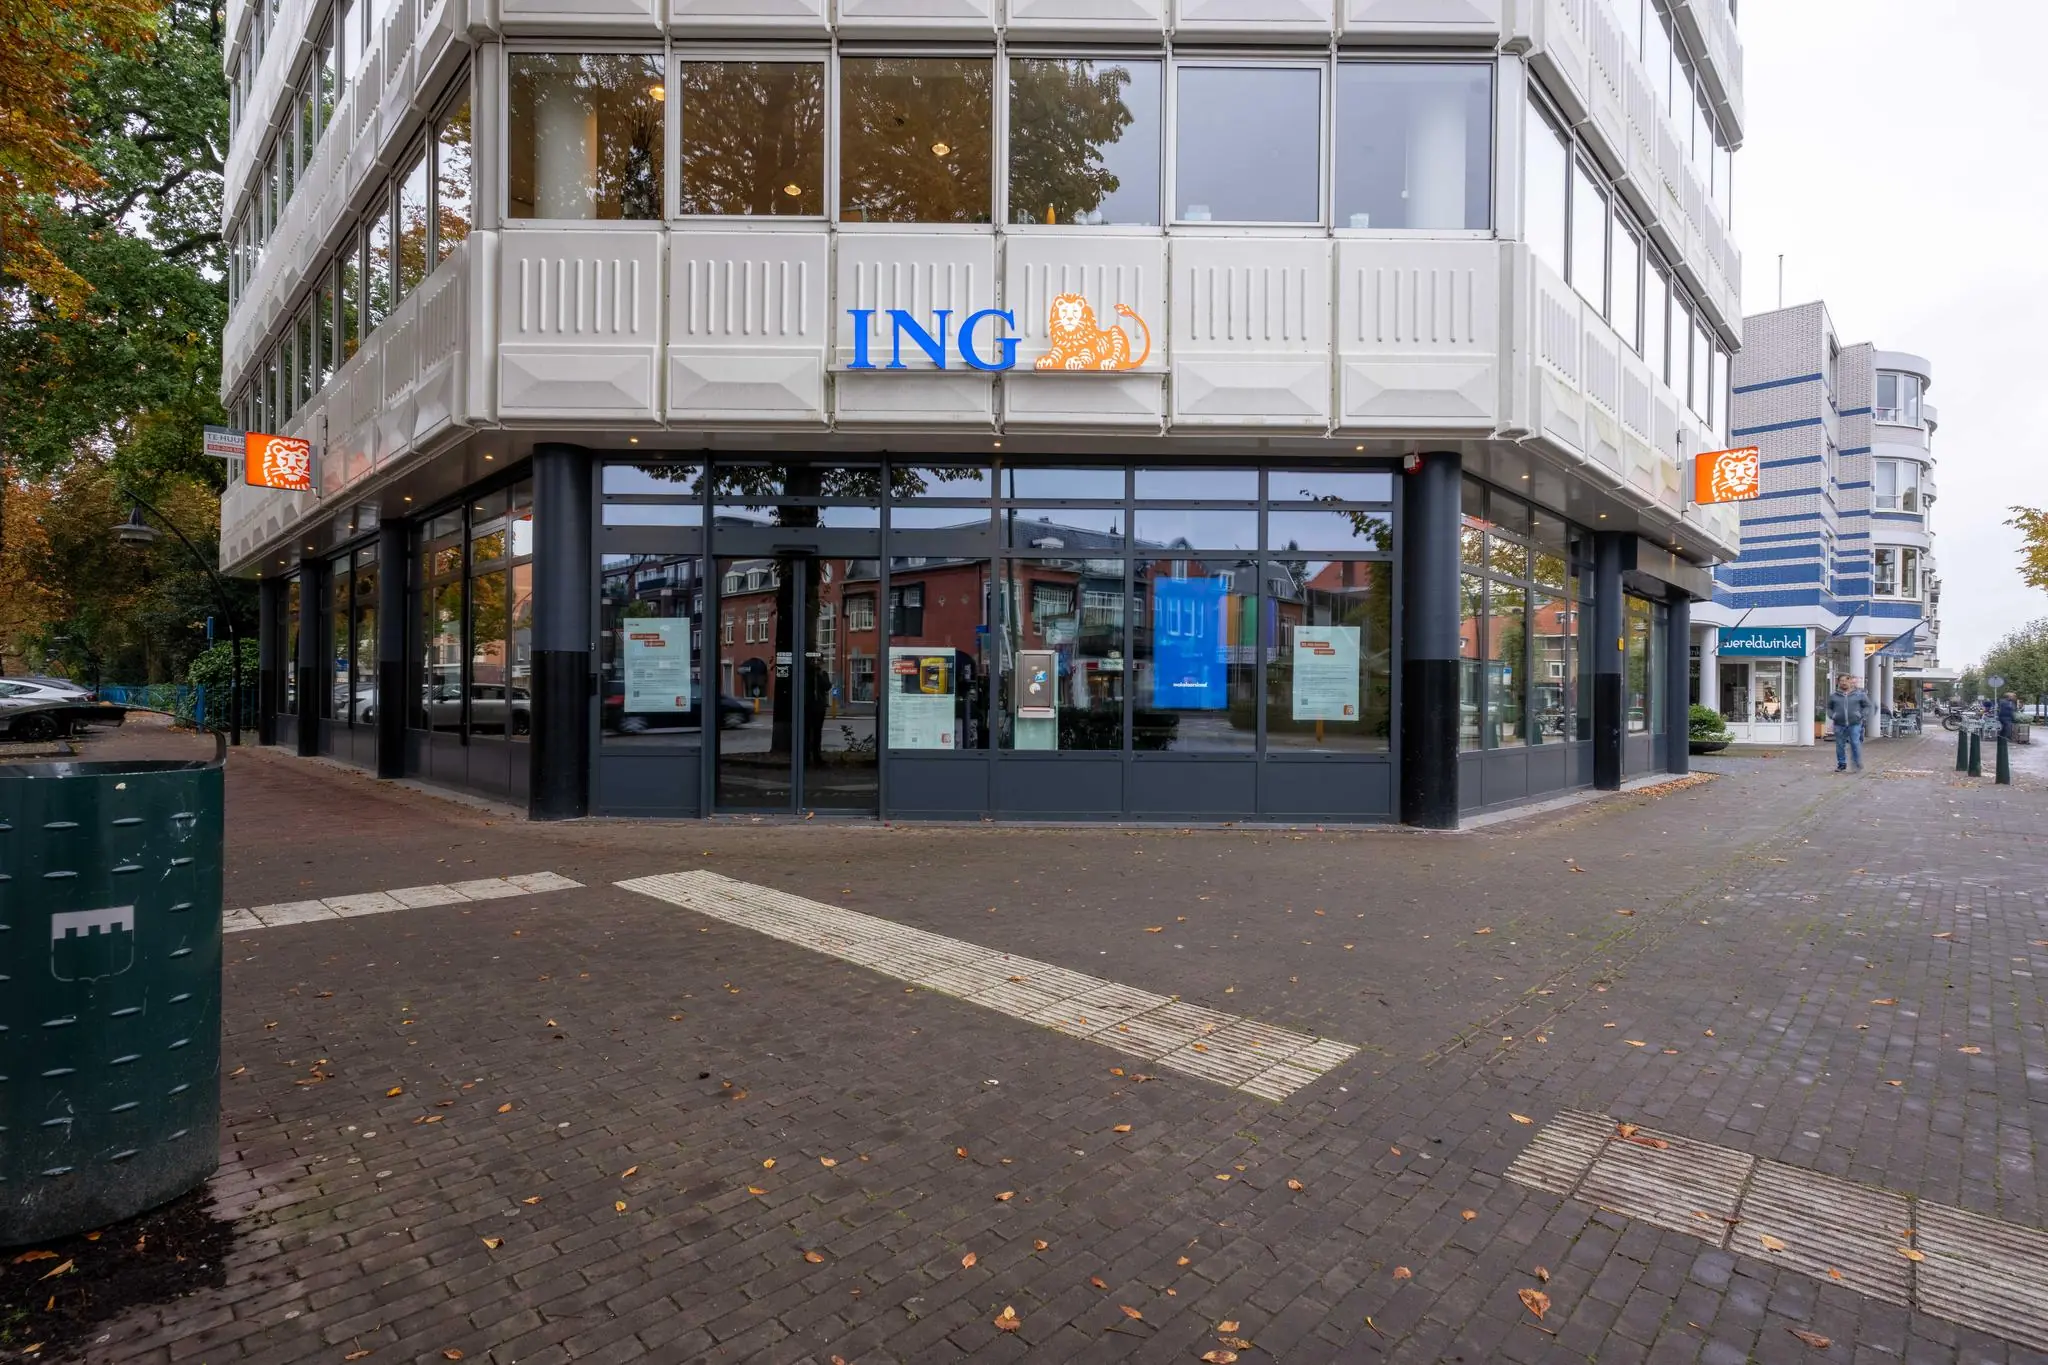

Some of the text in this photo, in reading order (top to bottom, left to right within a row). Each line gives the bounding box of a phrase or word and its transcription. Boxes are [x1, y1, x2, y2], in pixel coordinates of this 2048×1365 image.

[846, 308, 1022, 372] ING
[208, 433, 218, 441] TE
[1723, 634, 1802, 649] wereldwinkel
